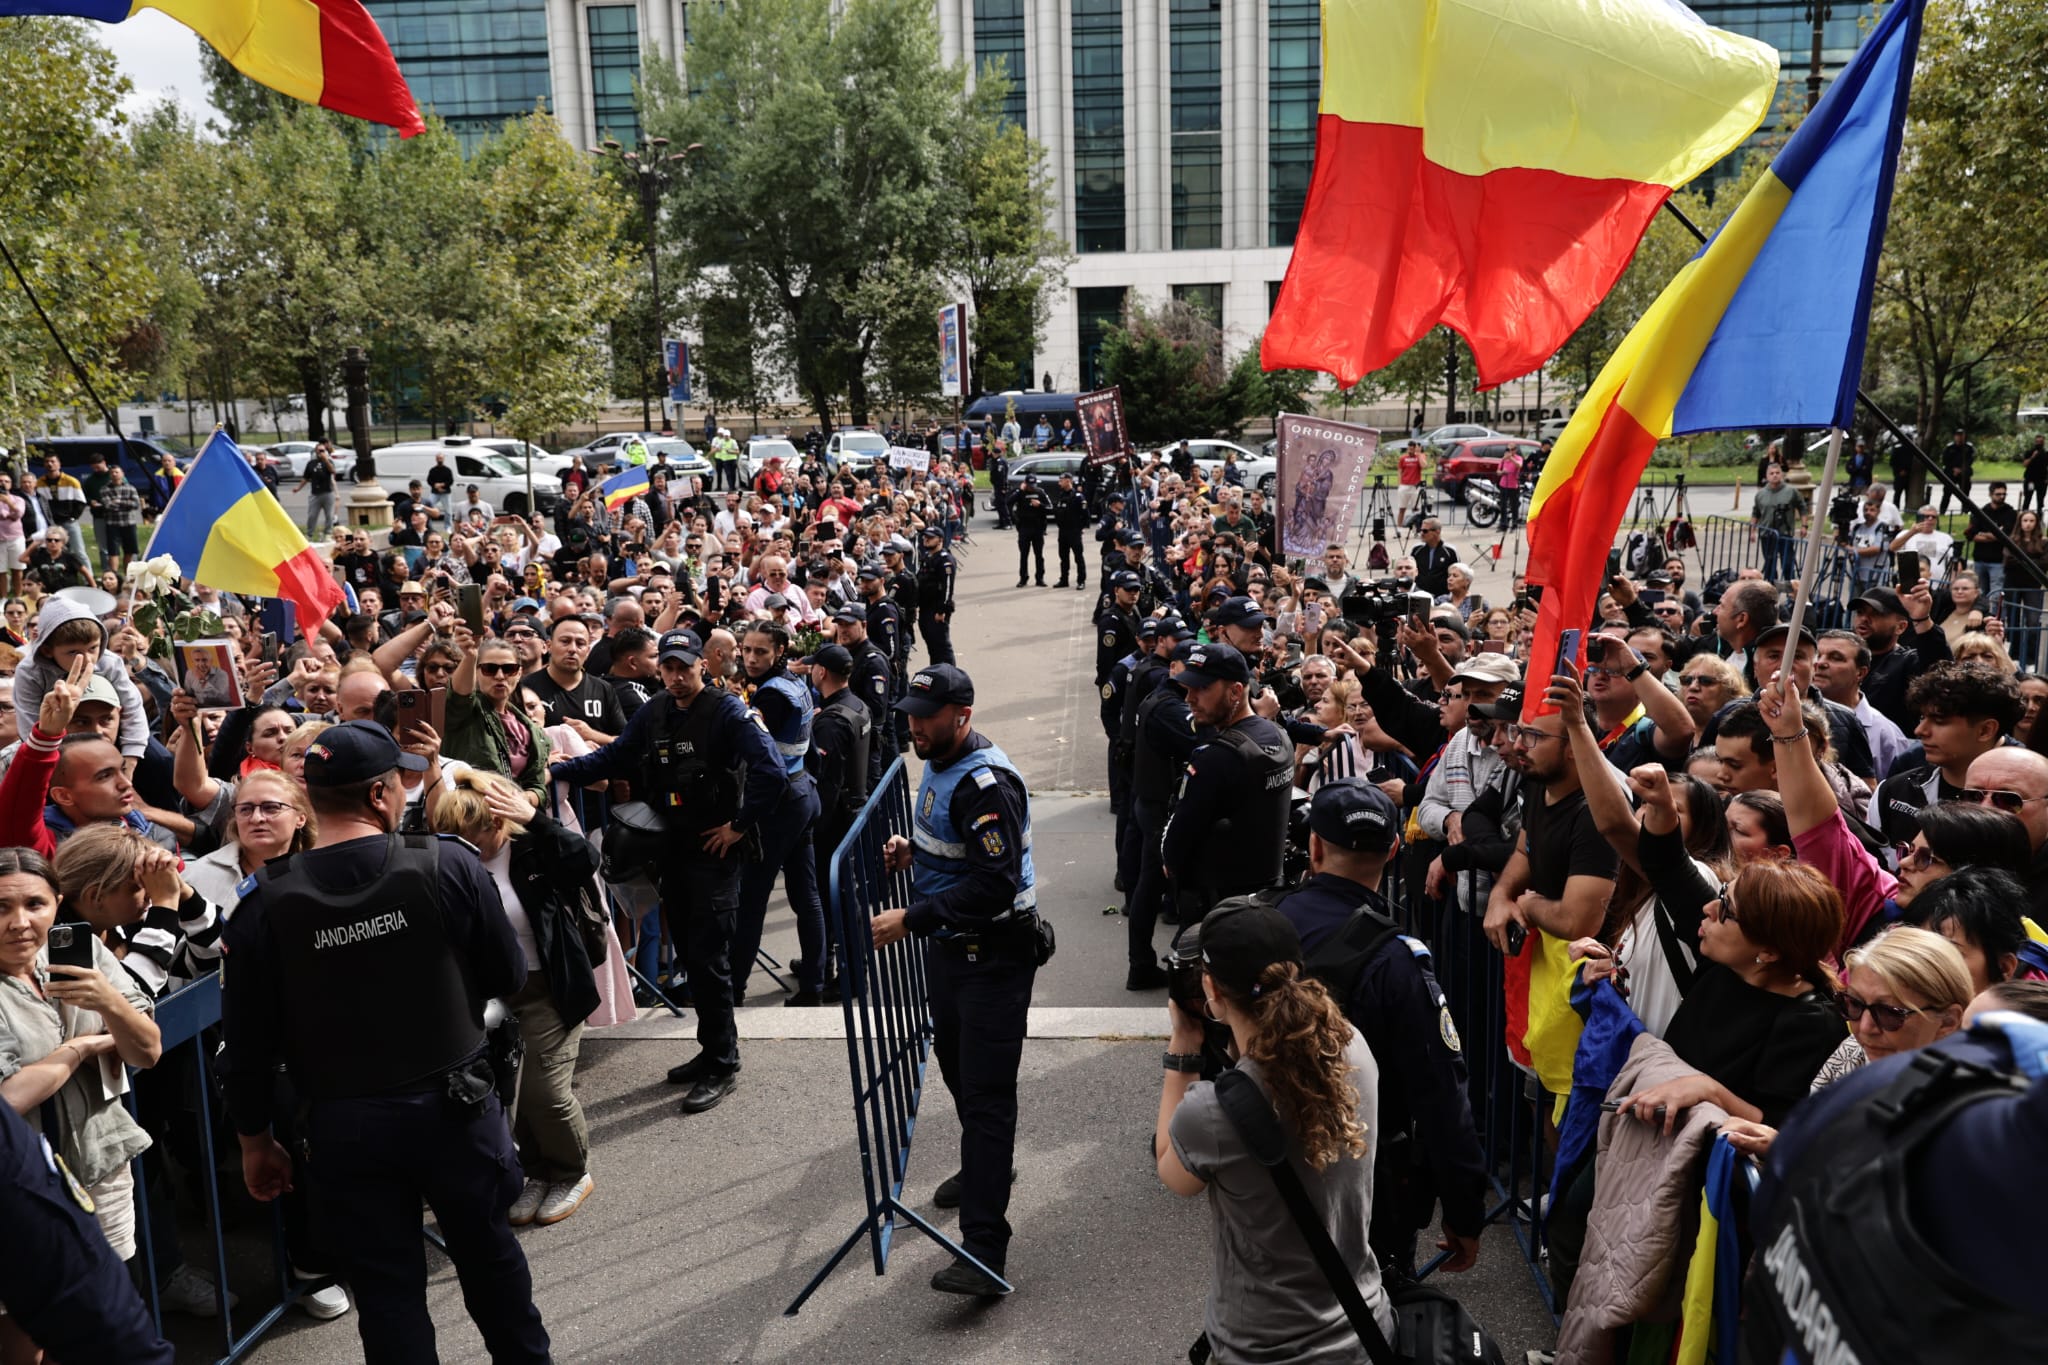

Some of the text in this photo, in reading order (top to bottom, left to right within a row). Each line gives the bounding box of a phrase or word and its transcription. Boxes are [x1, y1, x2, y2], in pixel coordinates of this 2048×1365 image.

[1291, 424, 1365, 447] ORTODOX
[584, 700, 602, 717] CO
[314, 910, 408, 950] JANDARMERIA
